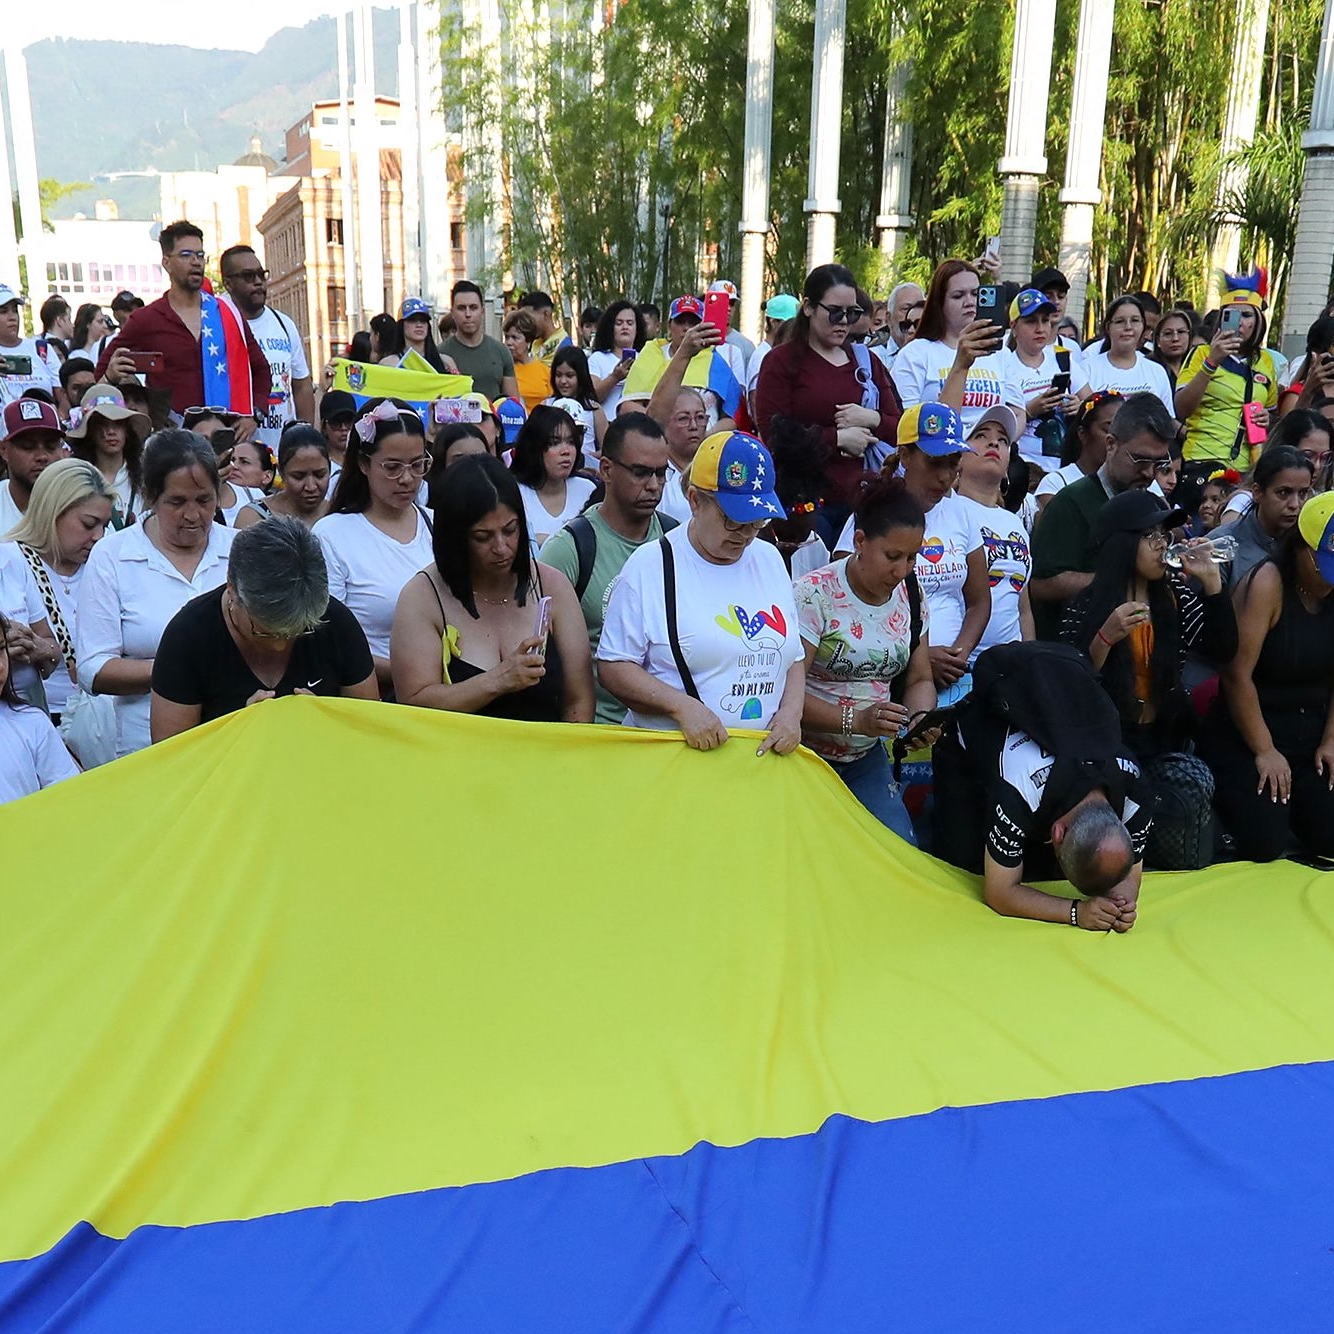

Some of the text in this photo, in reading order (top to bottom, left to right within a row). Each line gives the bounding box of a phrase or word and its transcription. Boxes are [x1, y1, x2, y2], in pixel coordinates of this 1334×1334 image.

[738, 653, 776, 668] LLEVO TU LUZ
[731, 683, 745, 697] EN
[746, 683, 758, 697] MI
